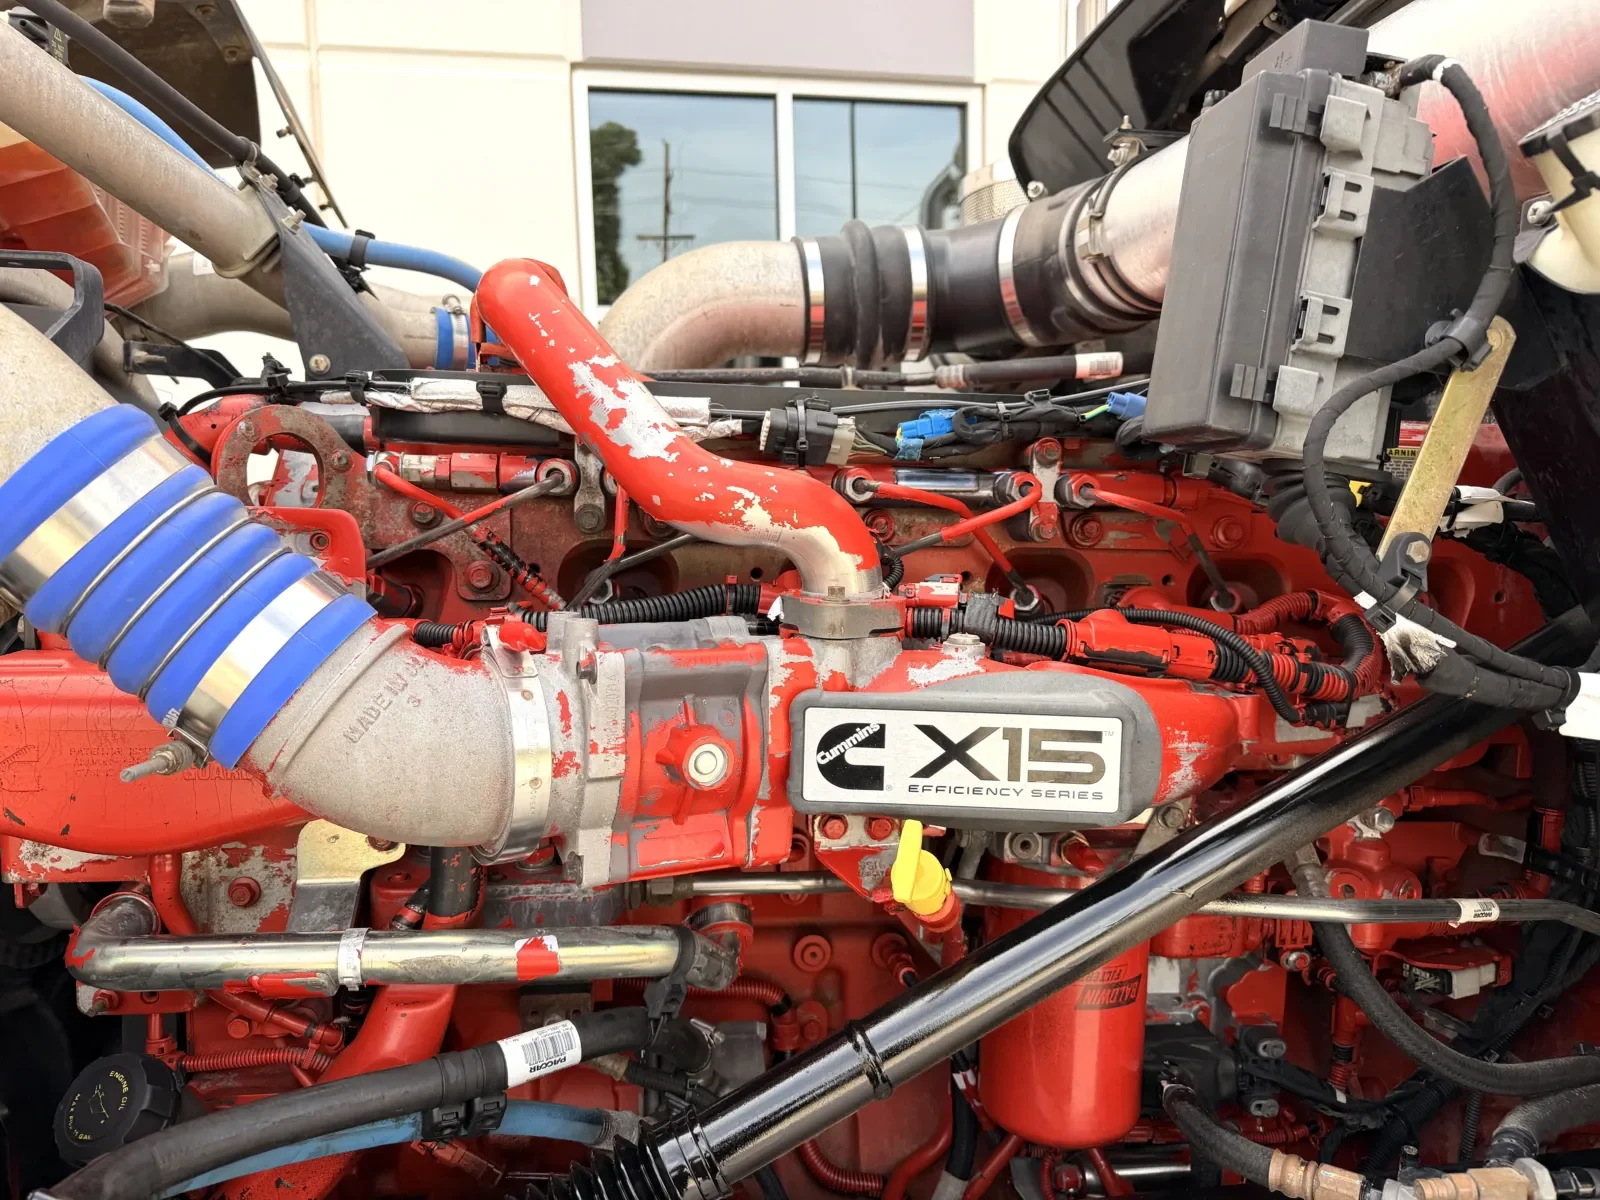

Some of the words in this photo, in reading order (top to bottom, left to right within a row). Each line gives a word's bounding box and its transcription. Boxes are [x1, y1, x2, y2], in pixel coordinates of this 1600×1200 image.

[1388, 449, 1418, 457] ARNIN
[343, 692, 392, 743] MADE
[816, 722, 880, 765] Cummins
[908, 724, 1106, 784] X15
[908, 784, 1024, 797] EFFICIENCY
[1031, 789, 1104, 800] SERIES
[1082, 968, 1123, 982] FILTER
[1083, 981, 1138, 1005] BALDWIN
[529, 1056, 567, 1074] PACCAR
[109, 1070, 129, 1093] ENGINE
[118, 1096, 128, 1111] OIL
